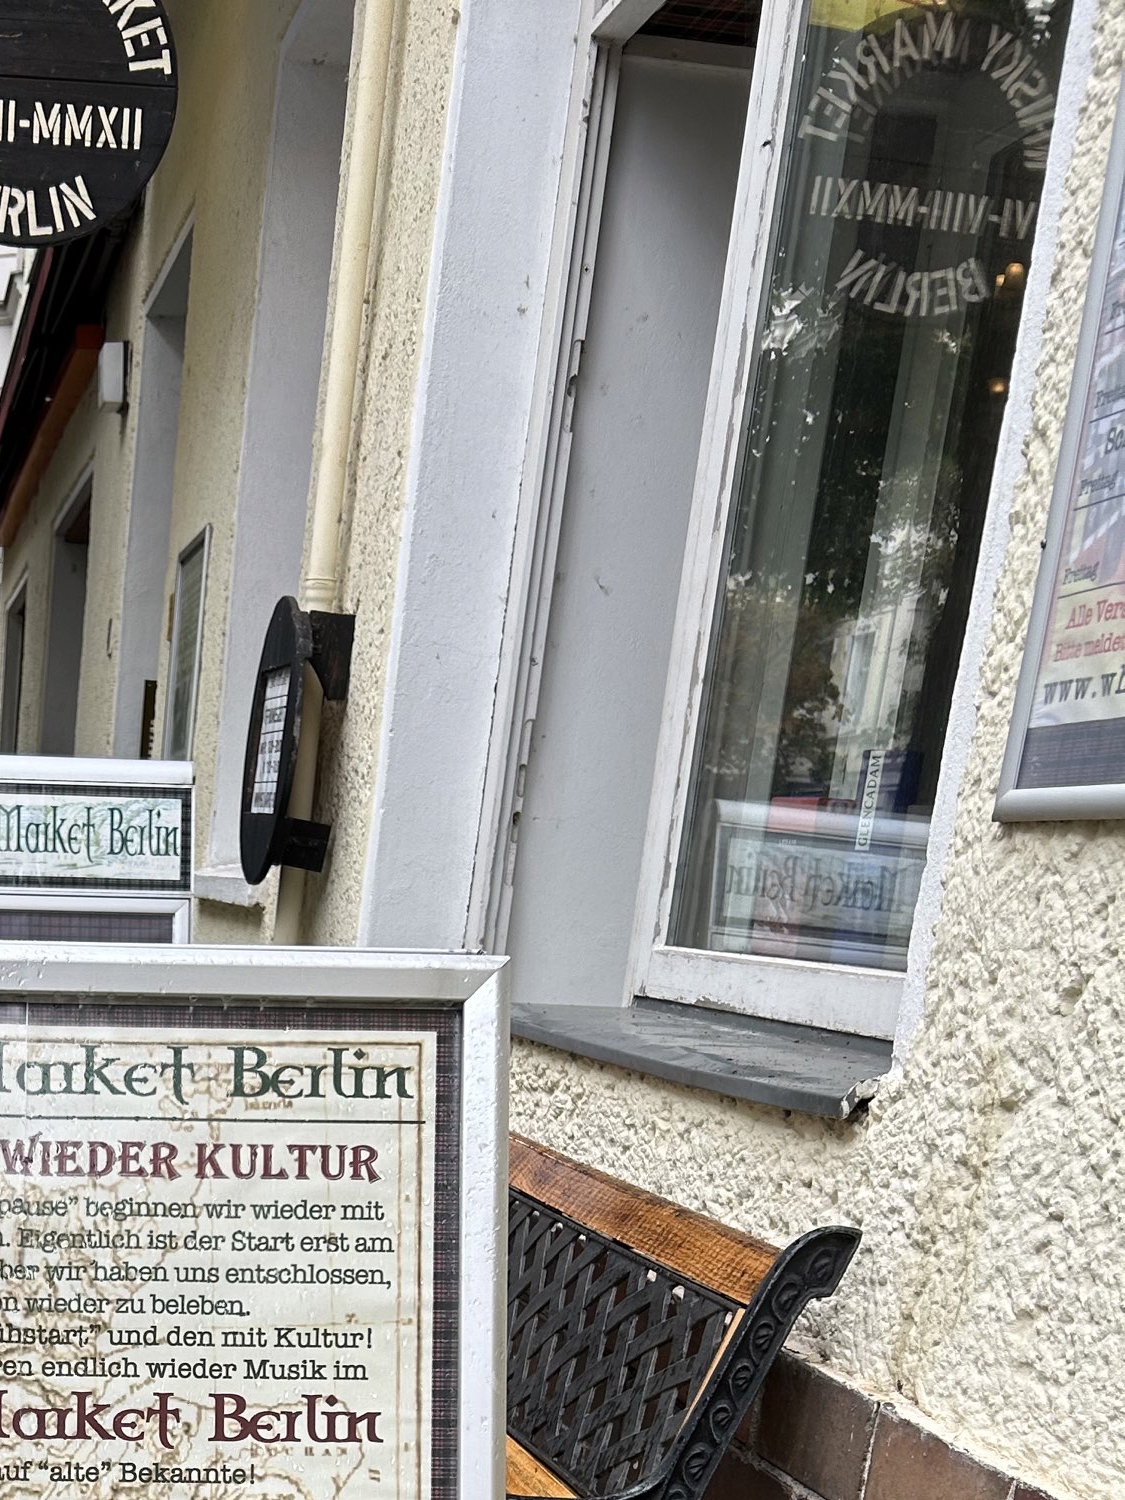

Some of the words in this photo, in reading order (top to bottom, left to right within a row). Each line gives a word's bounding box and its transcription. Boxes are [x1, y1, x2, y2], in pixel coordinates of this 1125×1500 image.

[98, 0, 173, 75] KET
[1065, 604, 1093, 629] Alle
[857, 754, 883, 847] GLENCADAM
[106, 807, 181, 857] Berlin
[228, 1046, 414, 1099] Berlin
[195, 1143, 381, 1184] KULTUR
[85, 1198, 197, 1221] beginnen
[204, 1199, 246, 1219] wir
[250, 1200, 336, 1220] wieder
[340, 1201, 385, 1221] mit
[17, 1228, 141, 1252] Eigentlich
[147, 1231, 178, 1250] ist
[183, 1231, 226, 1251] der
[231, 1231, 294, 1252] Start
[300, 1233, 350, 1252] erst
[354, 1237, 395, 1253] am
[46, 1263, 86, 1281] wir
[92, 1263, 170, 1283] haben
[174, 1266, 220, 1284] uns
[225, 1264, 392, 1289] entschlossen,
[25, 1294, 111, 1314] wieder
[116, 1298, 144, 1314] zu
[149, 1295, 251, 1318] beleben.
[107, 1326, 159, 1346] und
[166, 1326, 215, 1347] den
[221, 1327, 267, 1347] mit
[274, 1327, 373, 1349] Kultur!
[41, 1357, 140, 1378] endlich
[145, 1358, 237, 1379] wieder
[243, 1358, 327, 1381] Musik
[332, 1359, 369, 1381] im
[208, 1392, 384, 1443] Berlin
[118, 1462, 257, 1485] Bekannte!
